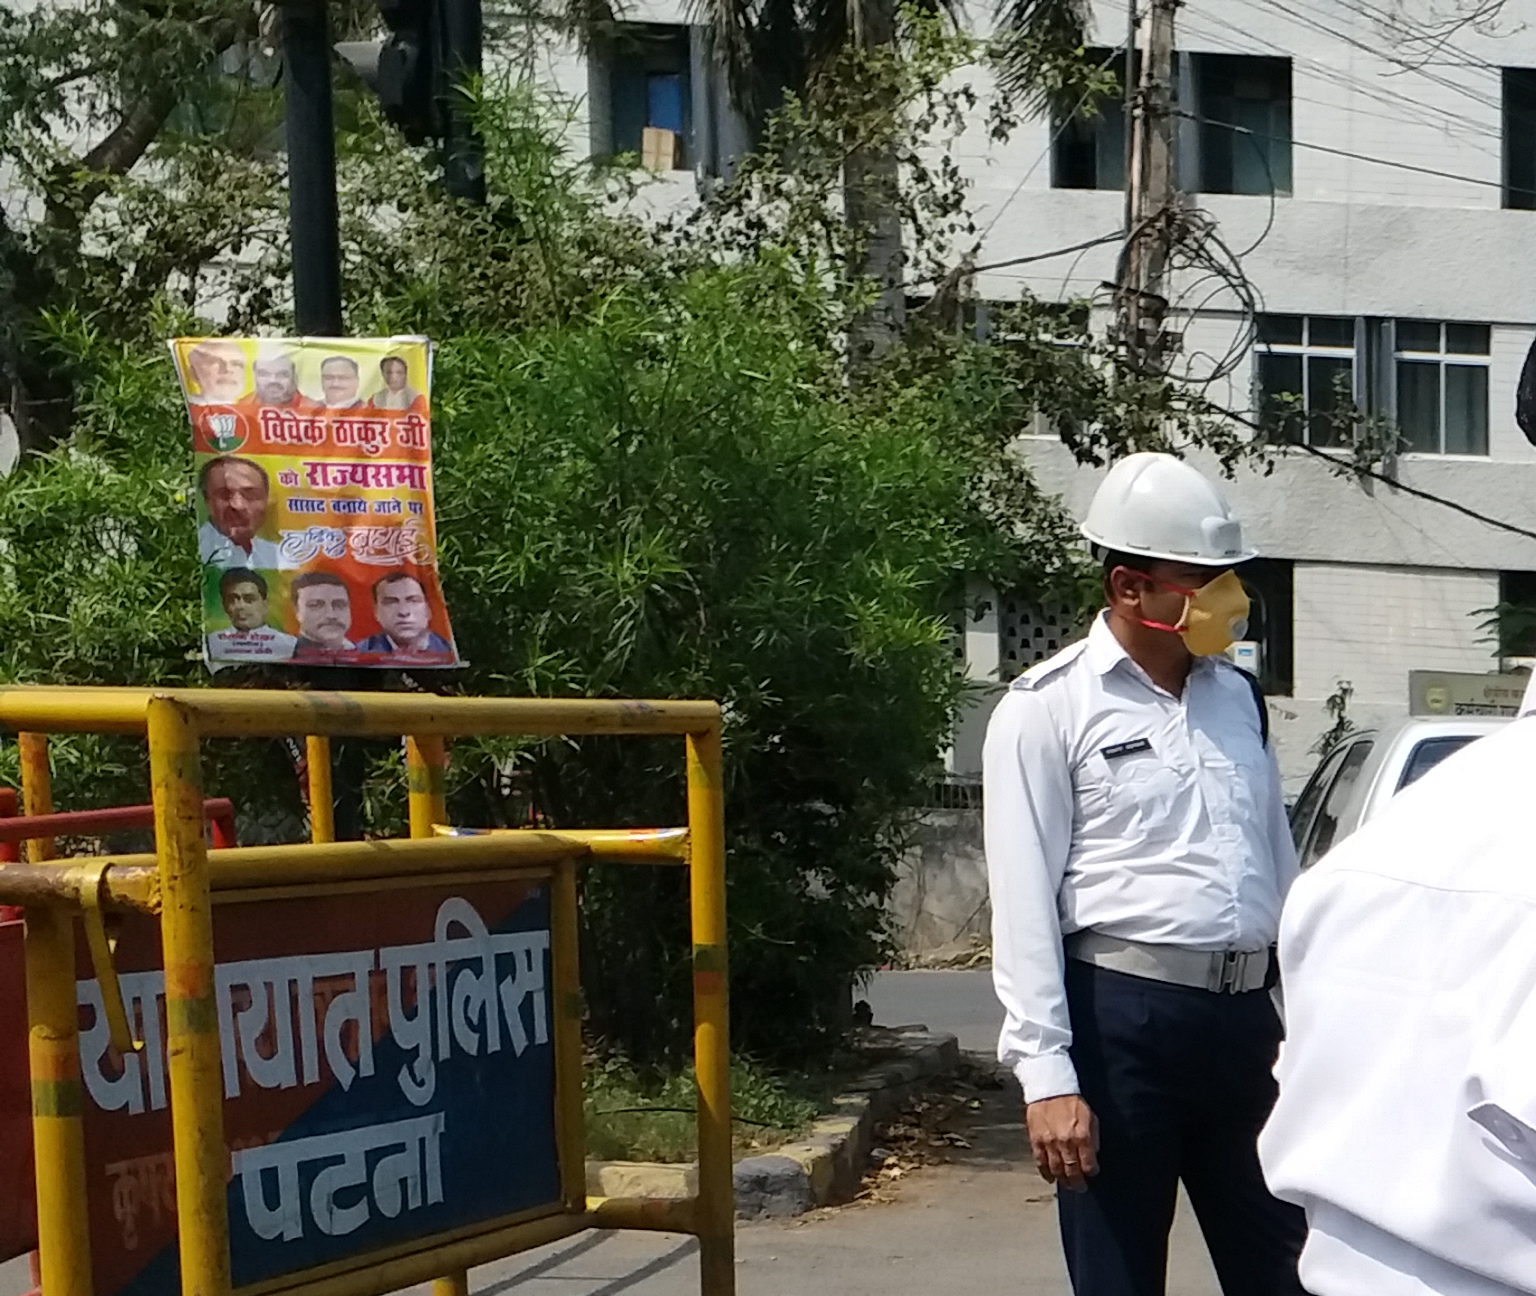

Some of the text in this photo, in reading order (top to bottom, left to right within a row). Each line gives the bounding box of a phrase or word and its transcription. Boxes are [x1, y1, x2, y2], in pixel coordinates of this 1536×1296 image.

[261, 409, 426, 454] विवेक ठाकुर जी
[374, 497, 402, 514] जाने
[380, 897, 549, 1106] पुलिस
[231, 1111, 445, 1242] पटना
